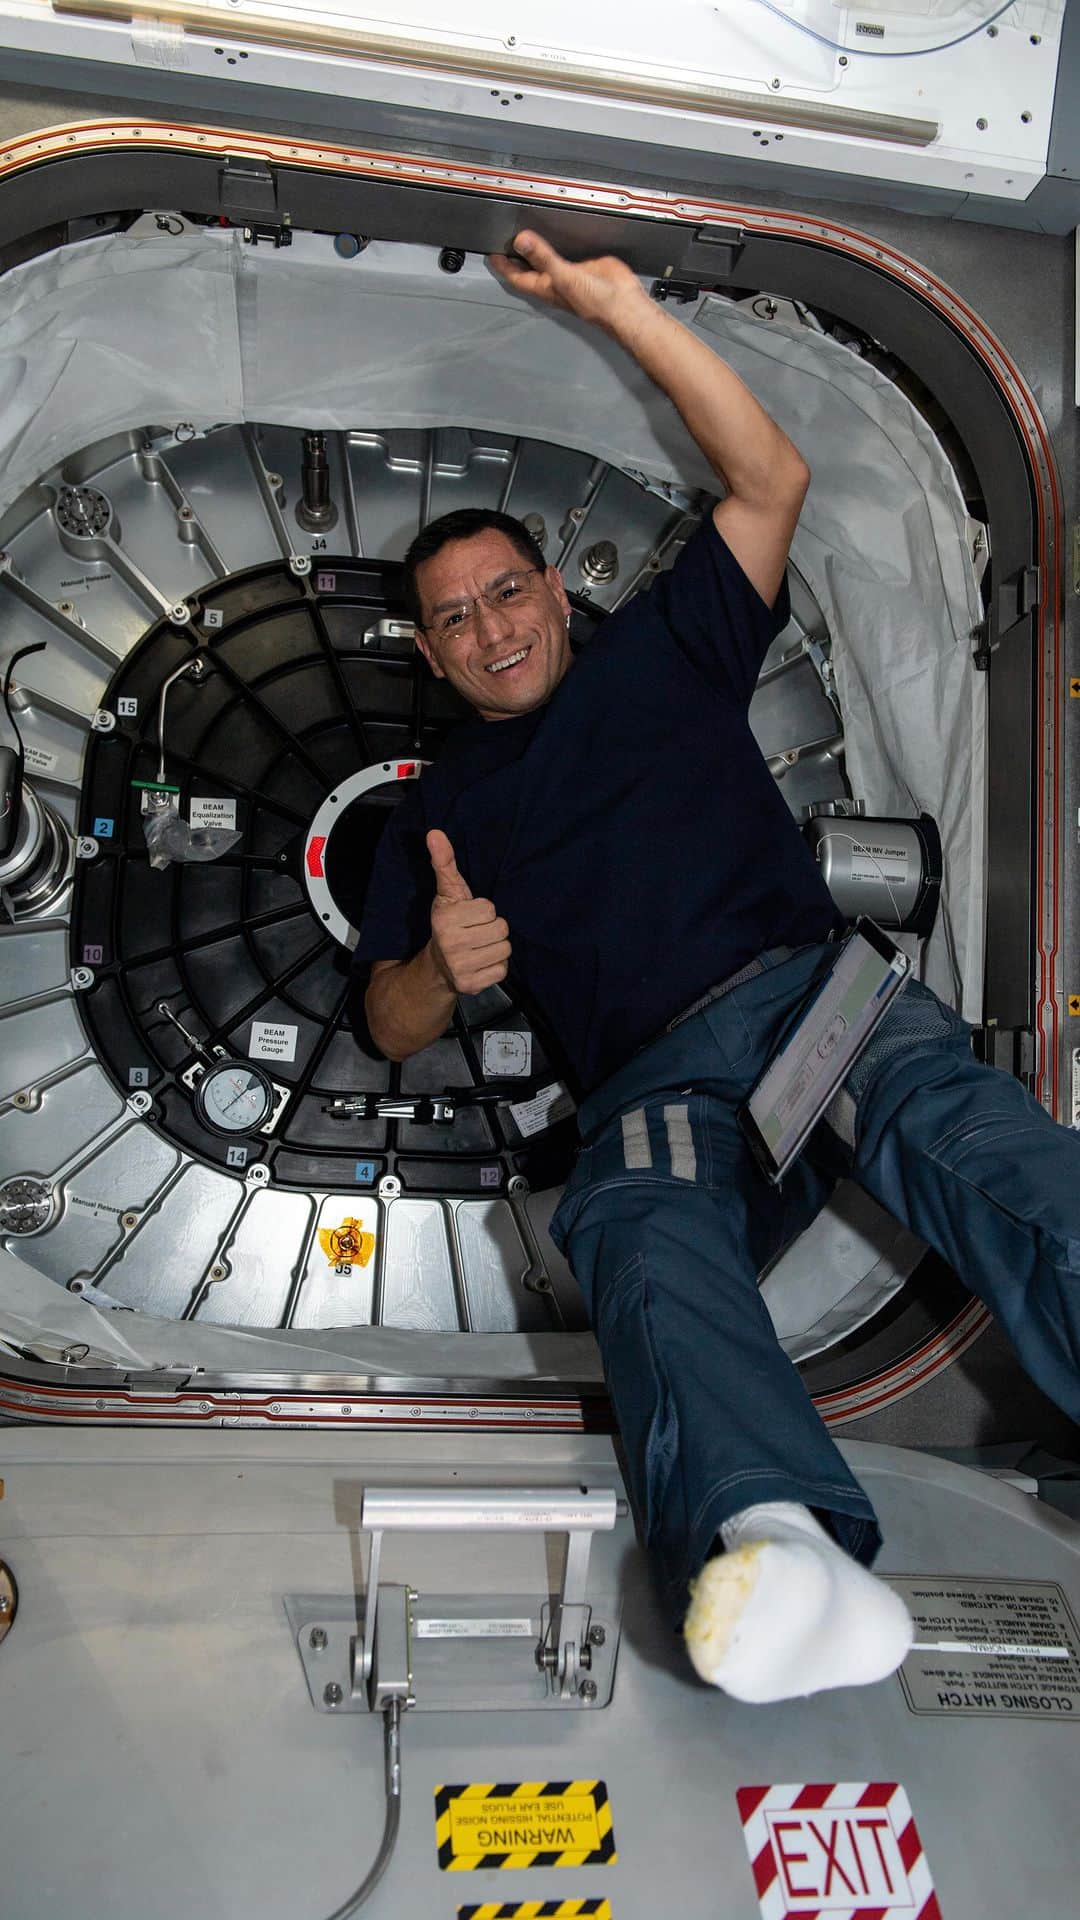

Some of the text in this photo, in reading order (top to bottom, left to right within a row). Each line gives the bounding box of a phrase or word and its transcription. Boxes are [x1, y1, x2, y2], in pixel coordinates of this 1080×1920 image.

[312, 539, 327, 550] J4
[320, 577, 334, 589] 11
[576, 587, 592, 601] J2
[209, 612, 218, 625] 5
[119, 701, 136, 713] 15
[203, 803, 224, 811] BEAM
[192, 811, 234, 820] Equalization
[99, 822, 109, 834] 2
[884, 848, 906, 857] Jumper
[85, 948, 101, 961] 10
[263, 1028, 285, 1037] BEAM
[258, 1036, 289, 1046] Pressure
[261, 1045, 284, 1055] Gauge
[134, 1071, 144, 1084] 8
[229, 1150, 245, 1163] 14
[360, 1166, 370, 1178] 4
[481, 1171, 498, 1183] 12
[72, 1196, 97, 1208] Manual
[336, 1262, 352, 1275] J5
[985, 1593, 1016, 1601] HANDLE
[929, 1616, 958, 1625] LATCH
[996, 1619, 1026, 1627] HANDLE
[1000, 1628, 1029, 1636] HANDLE
[1018, 1664, 1038, 1672] Push
[1046, 1666, 1074, 1674] HATCH
[1039, 1674, 1078, 1683] STOWAGE
[974, 1681, 1009, 1690] BUTTON
[1010, 1682, 1039, 1690] LATCH
[937, 1692, 1073, 1711] CLOSING HATCH
[481, 1802, 564, 1812] USE EAR PLUGS
[456, 1813, 593, 1826] POTENTIAL HISSING NOISE
[477, 1828, 575, 1847] WARNING
[772, 1819, 896, 1898] EXIT
